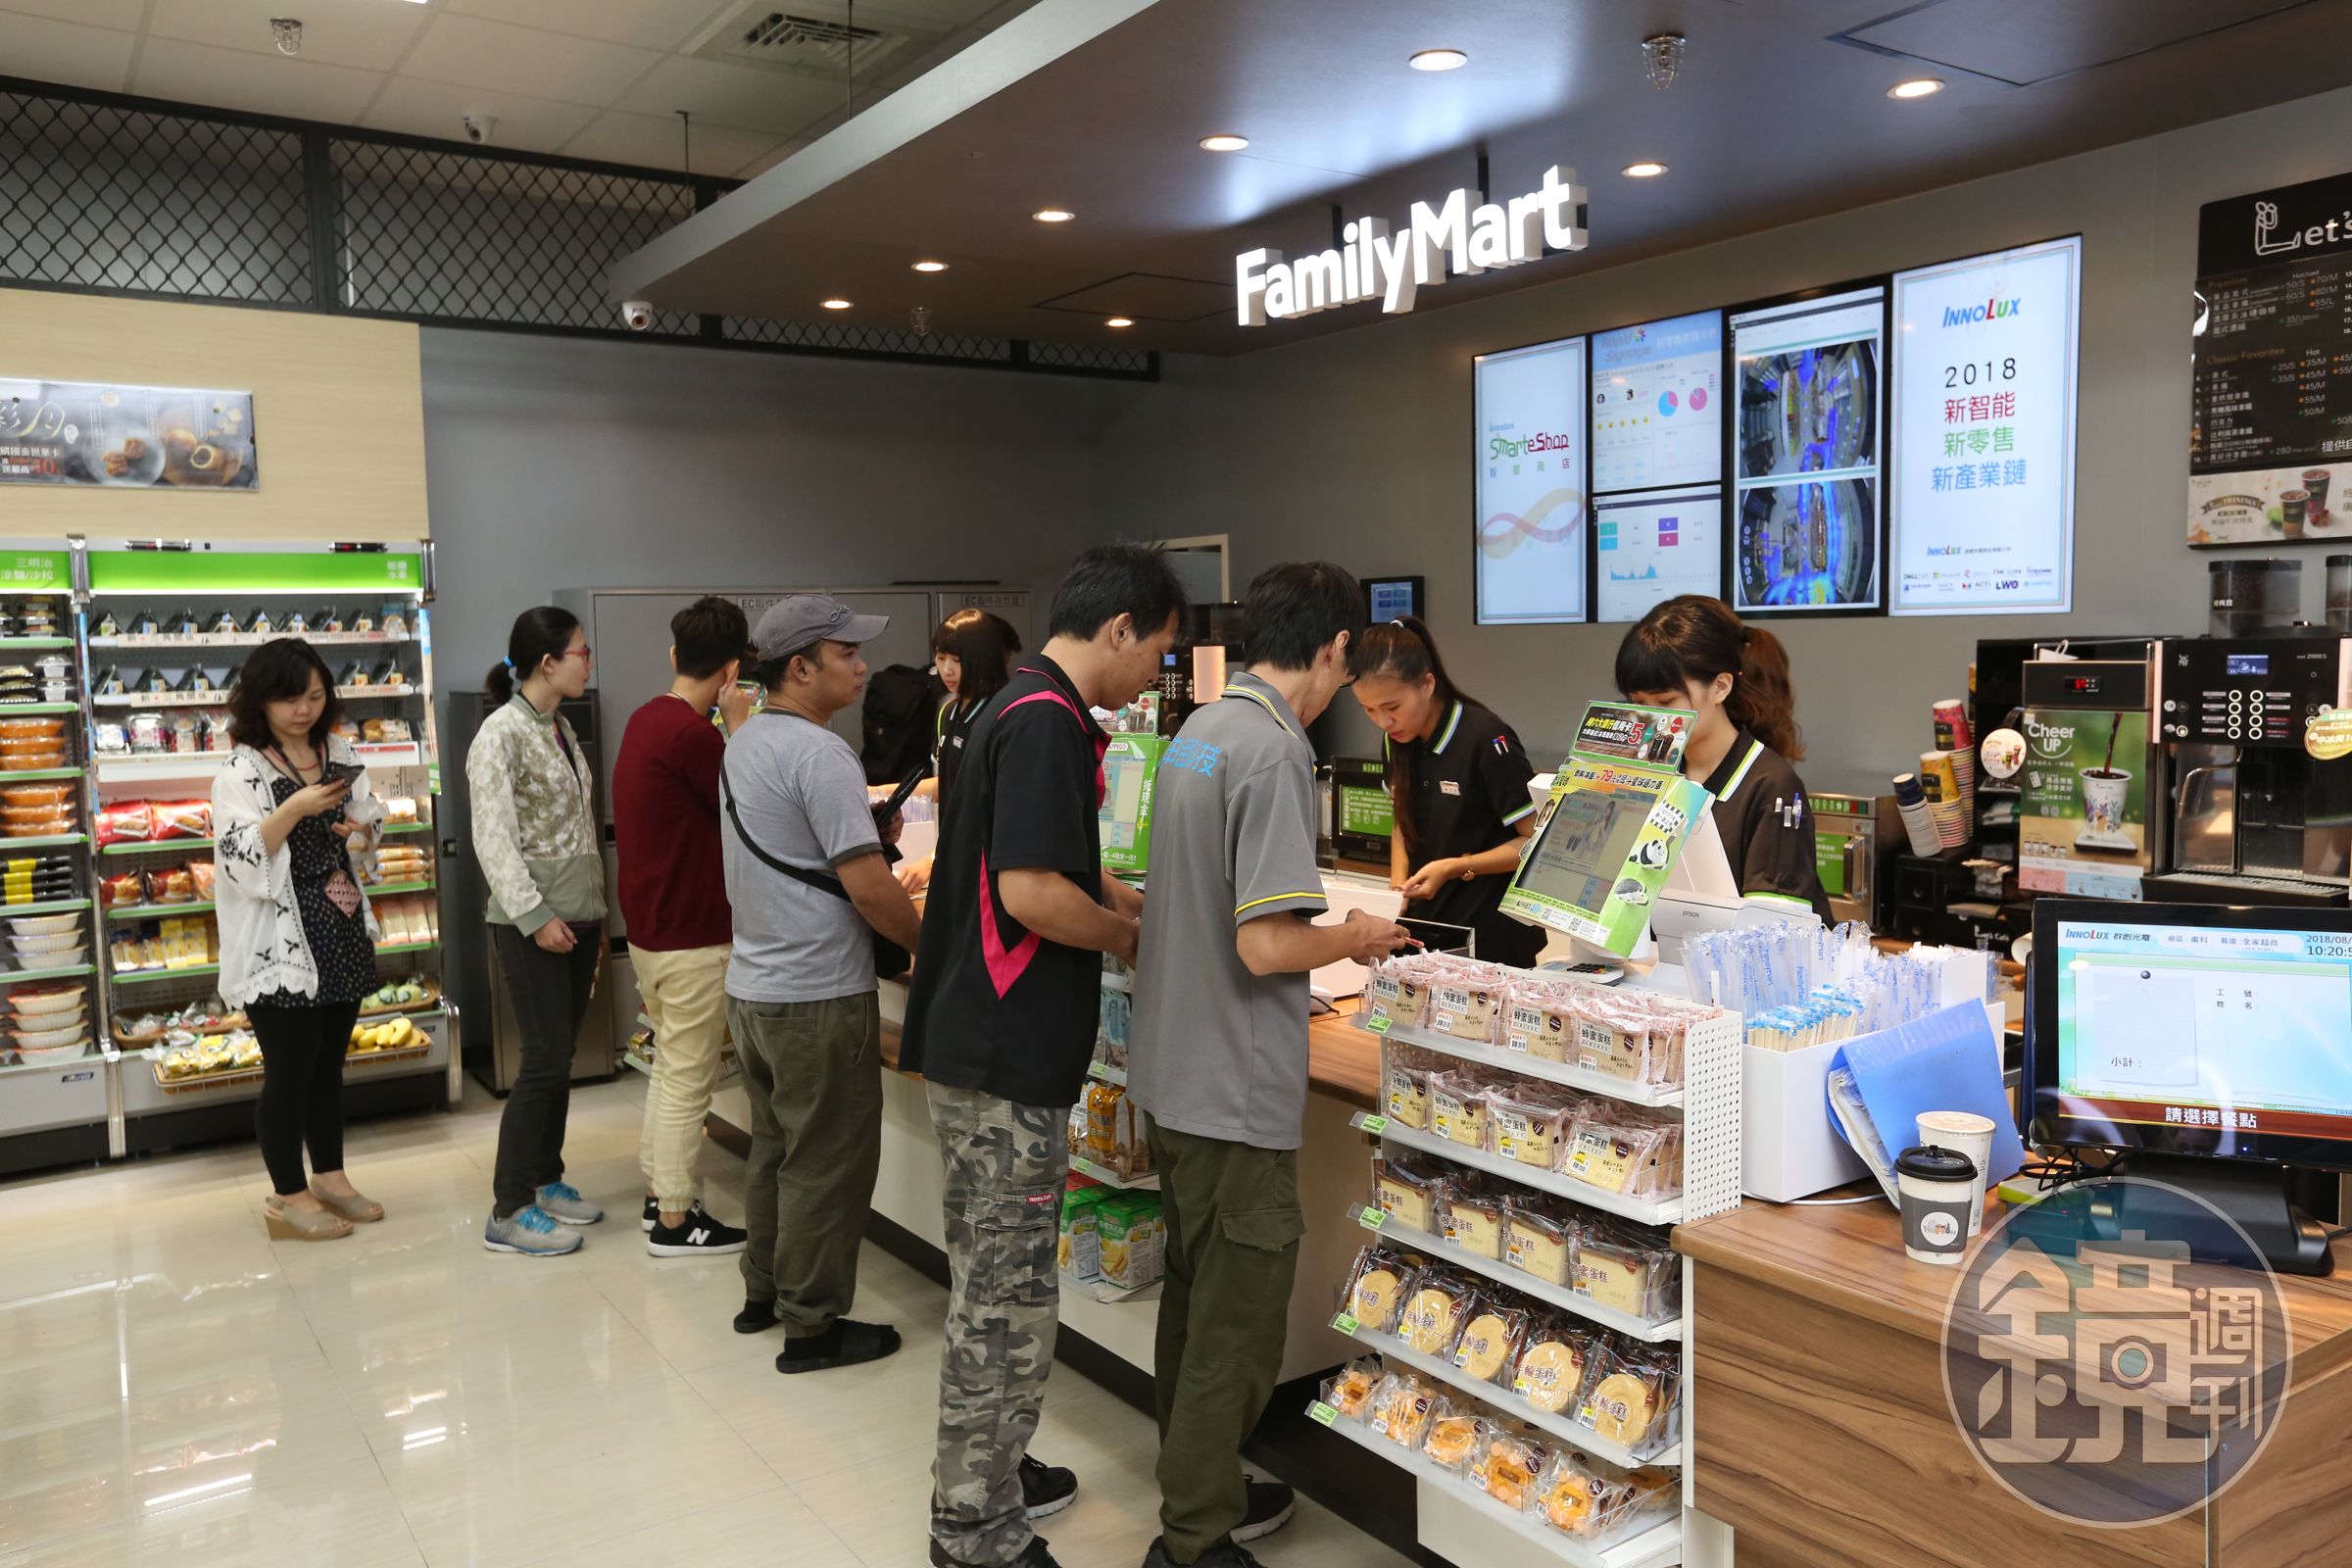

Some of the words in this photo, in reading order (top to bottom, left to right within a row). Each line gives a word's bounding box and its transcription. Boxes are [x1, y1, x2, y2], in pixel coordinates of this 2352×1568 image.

[1236, 165, 1587, 325] FamilyMart
[2339, 353, 2352, 362] 45/
[1944, 357, 2017, 388] 2018
[2339, 366, 2352, 375] 55/
[1944, 391, 2016, 425] 新智能
[1943, 425, 2015, 459] 新零售
[1932, 458, 2028, 494] 新產業鏈
[2028, 723, 2076, 739] Cheer
[2042, 738, 2062, 753] UP
[1682, 909, 1700, 918] EPSON
[2113, 932, 2151, 942] 群創光電
[1513, 1009, 1542, 1027] 蜂蜜蛋糕
[1581, 1027, 1612, 1048] 蜂蜜蛋糕
[2164, 1105, 2258, 1129] 請選擇餐點
[686, 1227, 710, 1246] N
[1590, 1393, 1628, 1420] 年輪蛋糕
